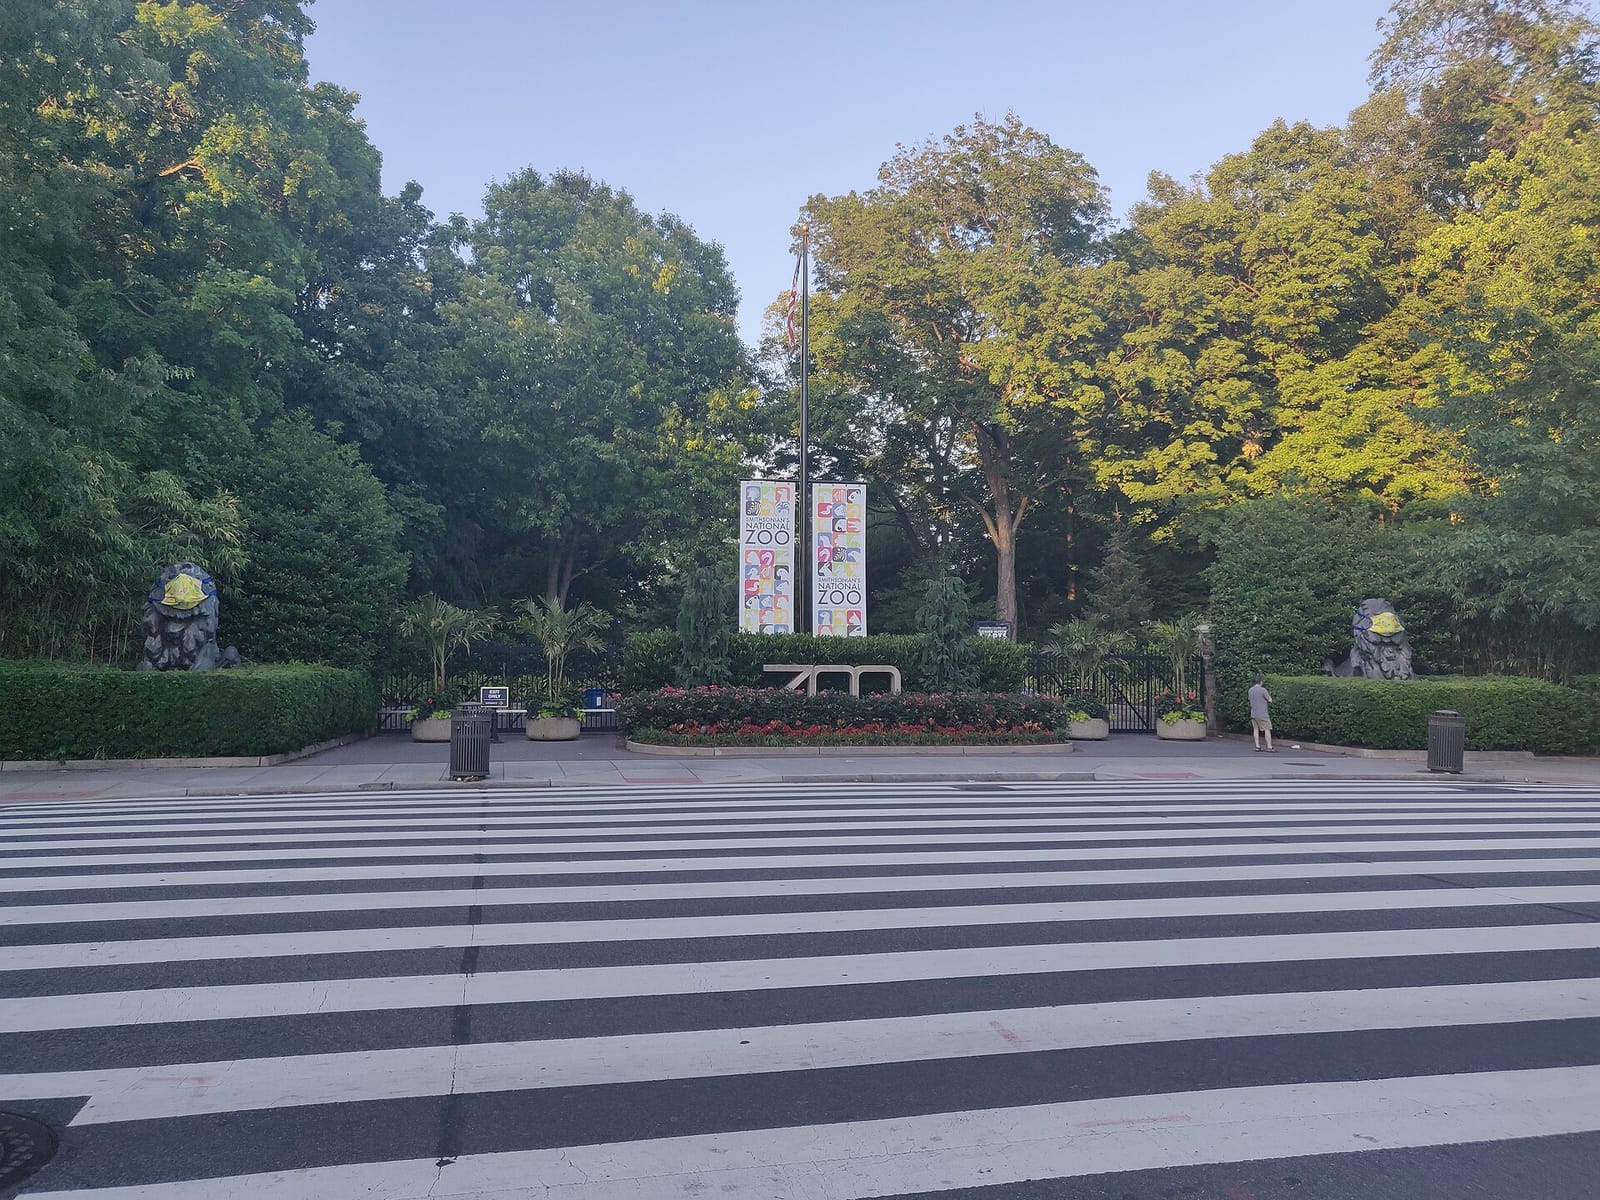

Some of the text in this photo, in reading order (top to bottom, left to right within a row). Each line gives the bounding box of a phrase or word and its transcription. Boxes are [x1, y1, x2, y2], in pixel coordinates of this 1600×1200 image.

[745, 522, 790, 530] NATIONAL
[745, 529, 790, 545] ZOO
[818, 582, 861, 590] NATIONAL
[817, 590, 862, 605] ZOO
